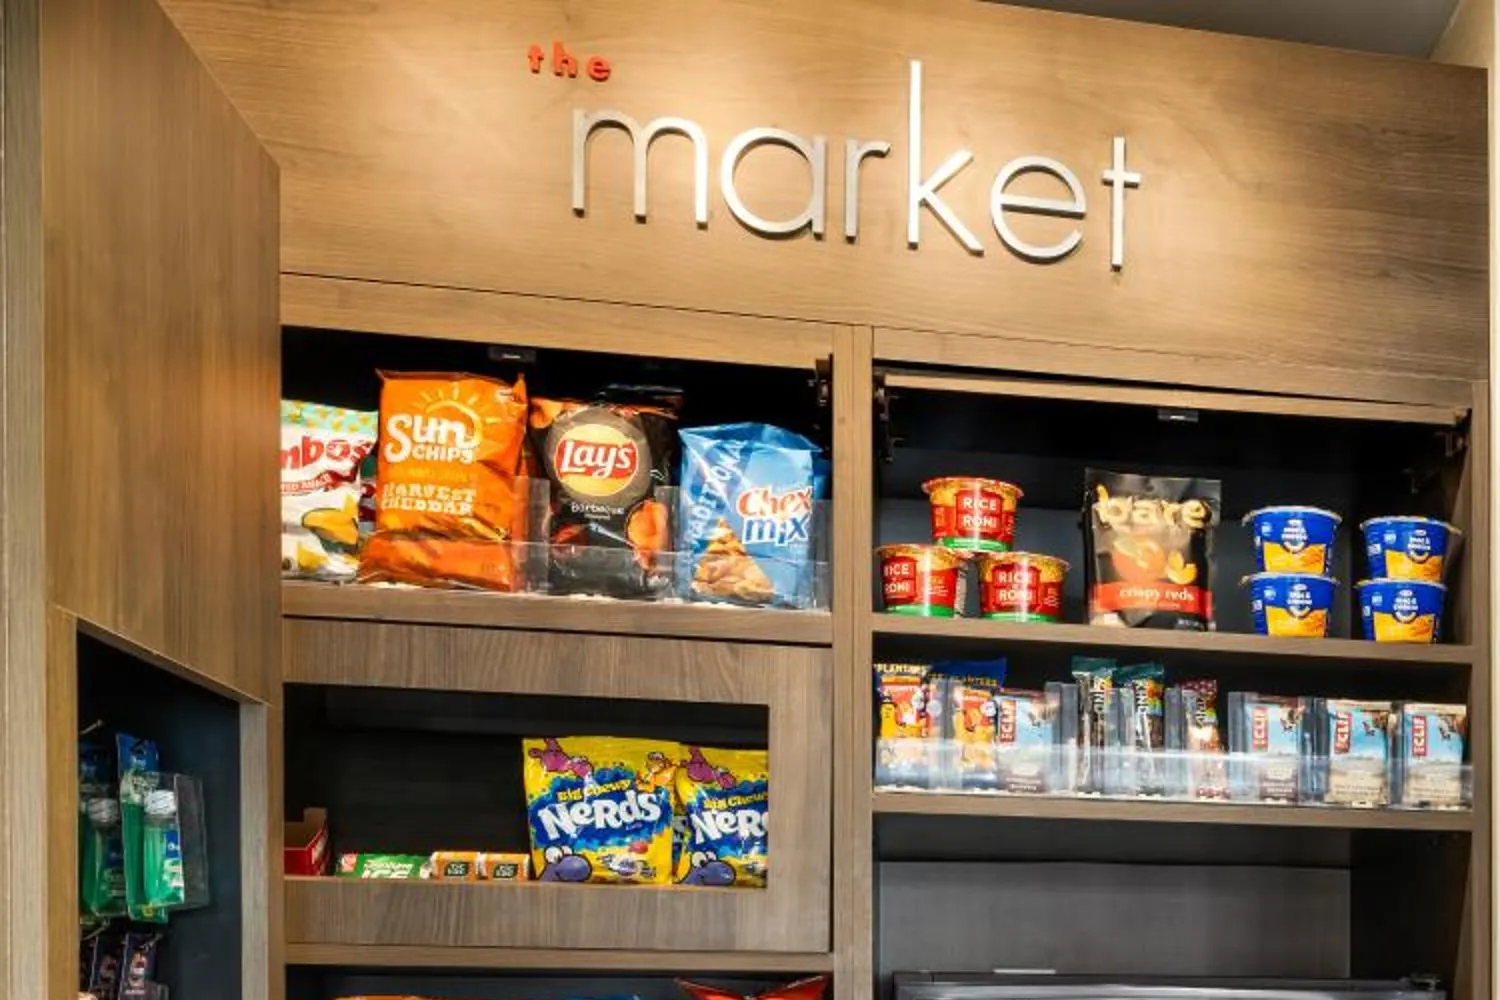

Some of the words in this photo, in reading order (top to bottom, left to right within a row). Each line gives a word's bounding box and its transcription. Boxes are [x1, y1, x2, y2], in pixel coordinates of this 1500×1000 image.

[527, 41, 612, 81] the
[573, 59, 1142, 272] market
[281, 435, 375, 470] mbos
[384, 412, 481, 463] Sun
[411, 444, 475, 464] CHIPS
[736, 485, 814, 519] Chex
[962, 497, 998, 511] RICE
[1096, 484, 1207, 528] bare
[962, 515, 998, 529] RONI
